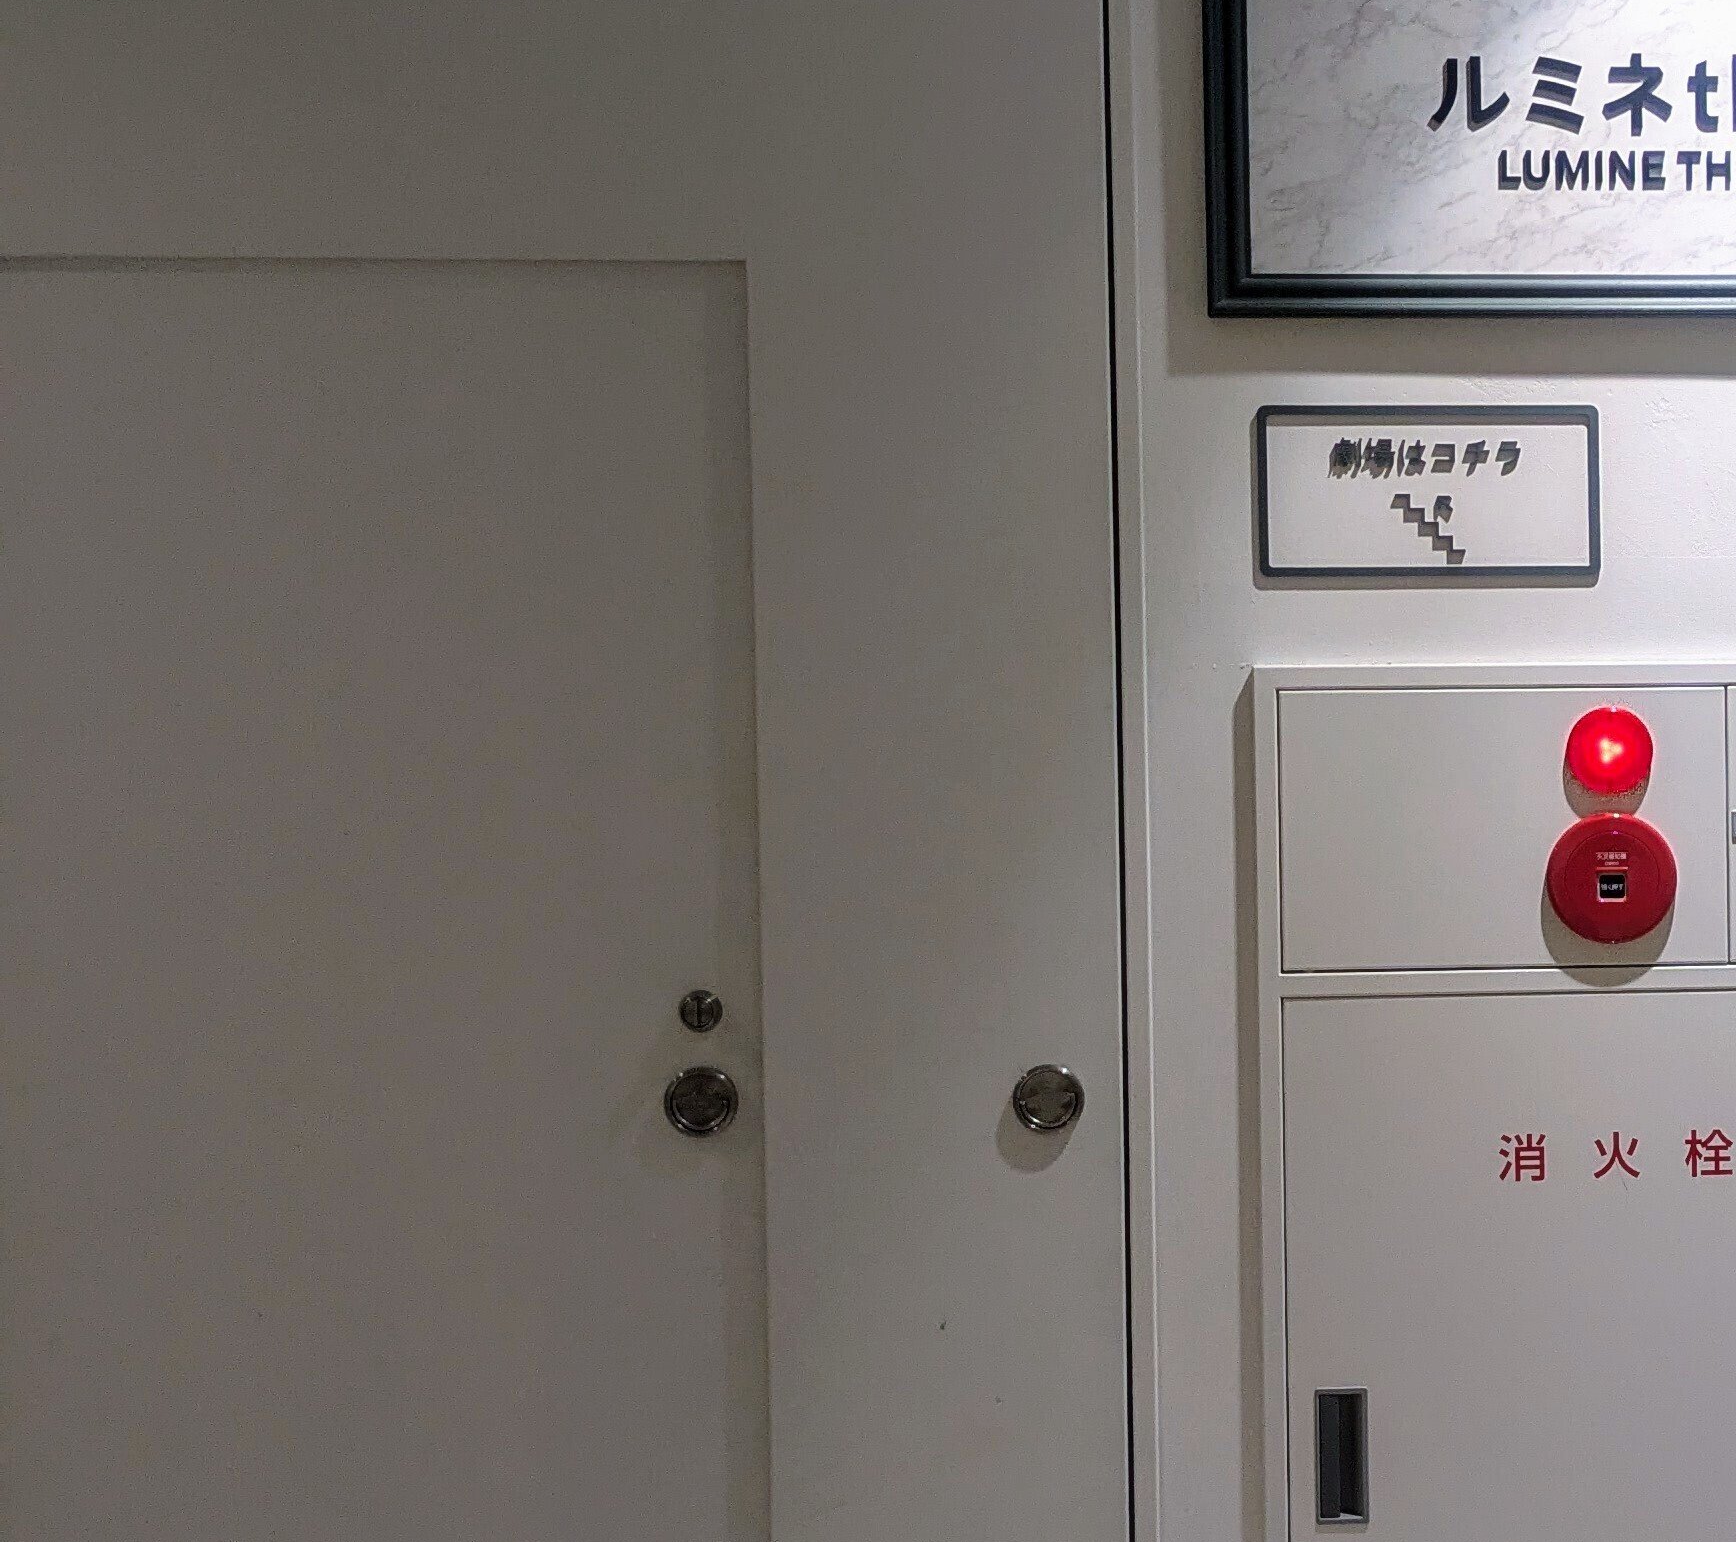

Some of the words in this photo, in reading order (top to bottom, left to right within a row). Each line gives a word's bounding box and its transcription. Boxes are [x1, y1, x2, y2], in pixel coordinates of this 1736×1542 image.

[1498, 149, 1666, 191] LUMINE
[1327, 437, 1521, 479] 劇場はコチラ
[1498, 1129, 1734, 1182] 消火栓
